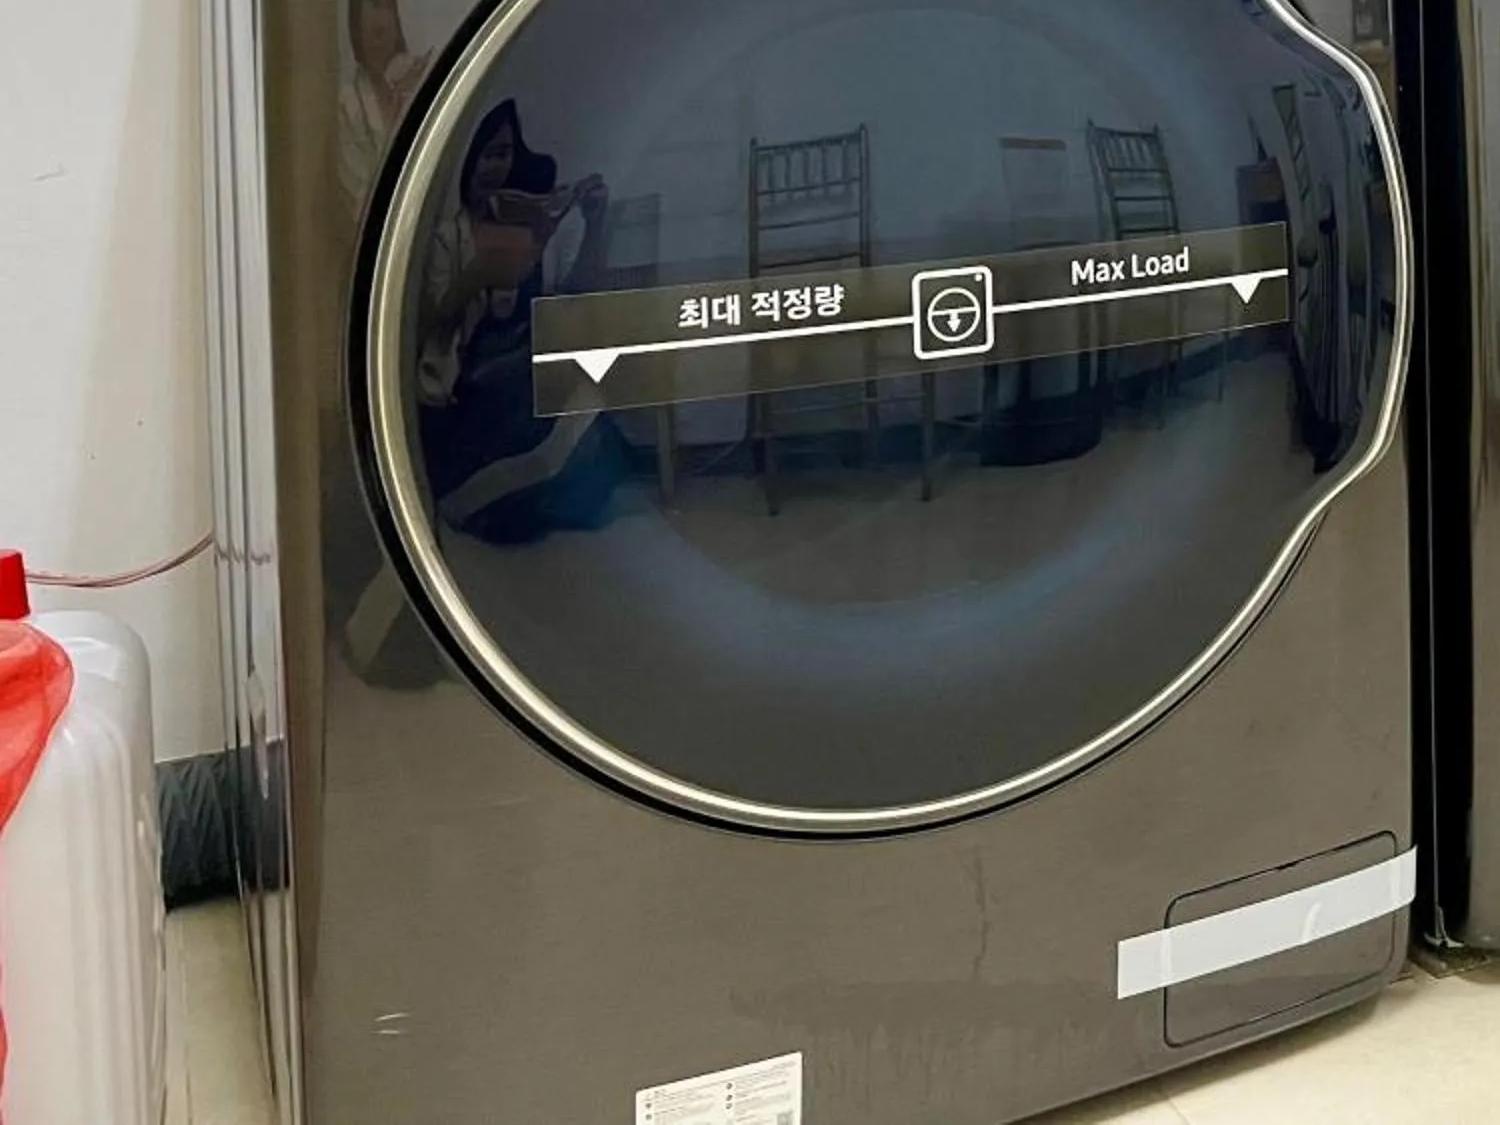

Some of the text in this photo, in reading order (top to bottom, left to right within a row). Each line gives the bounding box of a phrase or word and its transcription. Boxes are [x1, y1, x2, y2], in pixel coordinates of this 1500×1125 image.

[1071, 245, 1190, 287] Max Load
[678, 283, 846, 329] 최대 적정량
